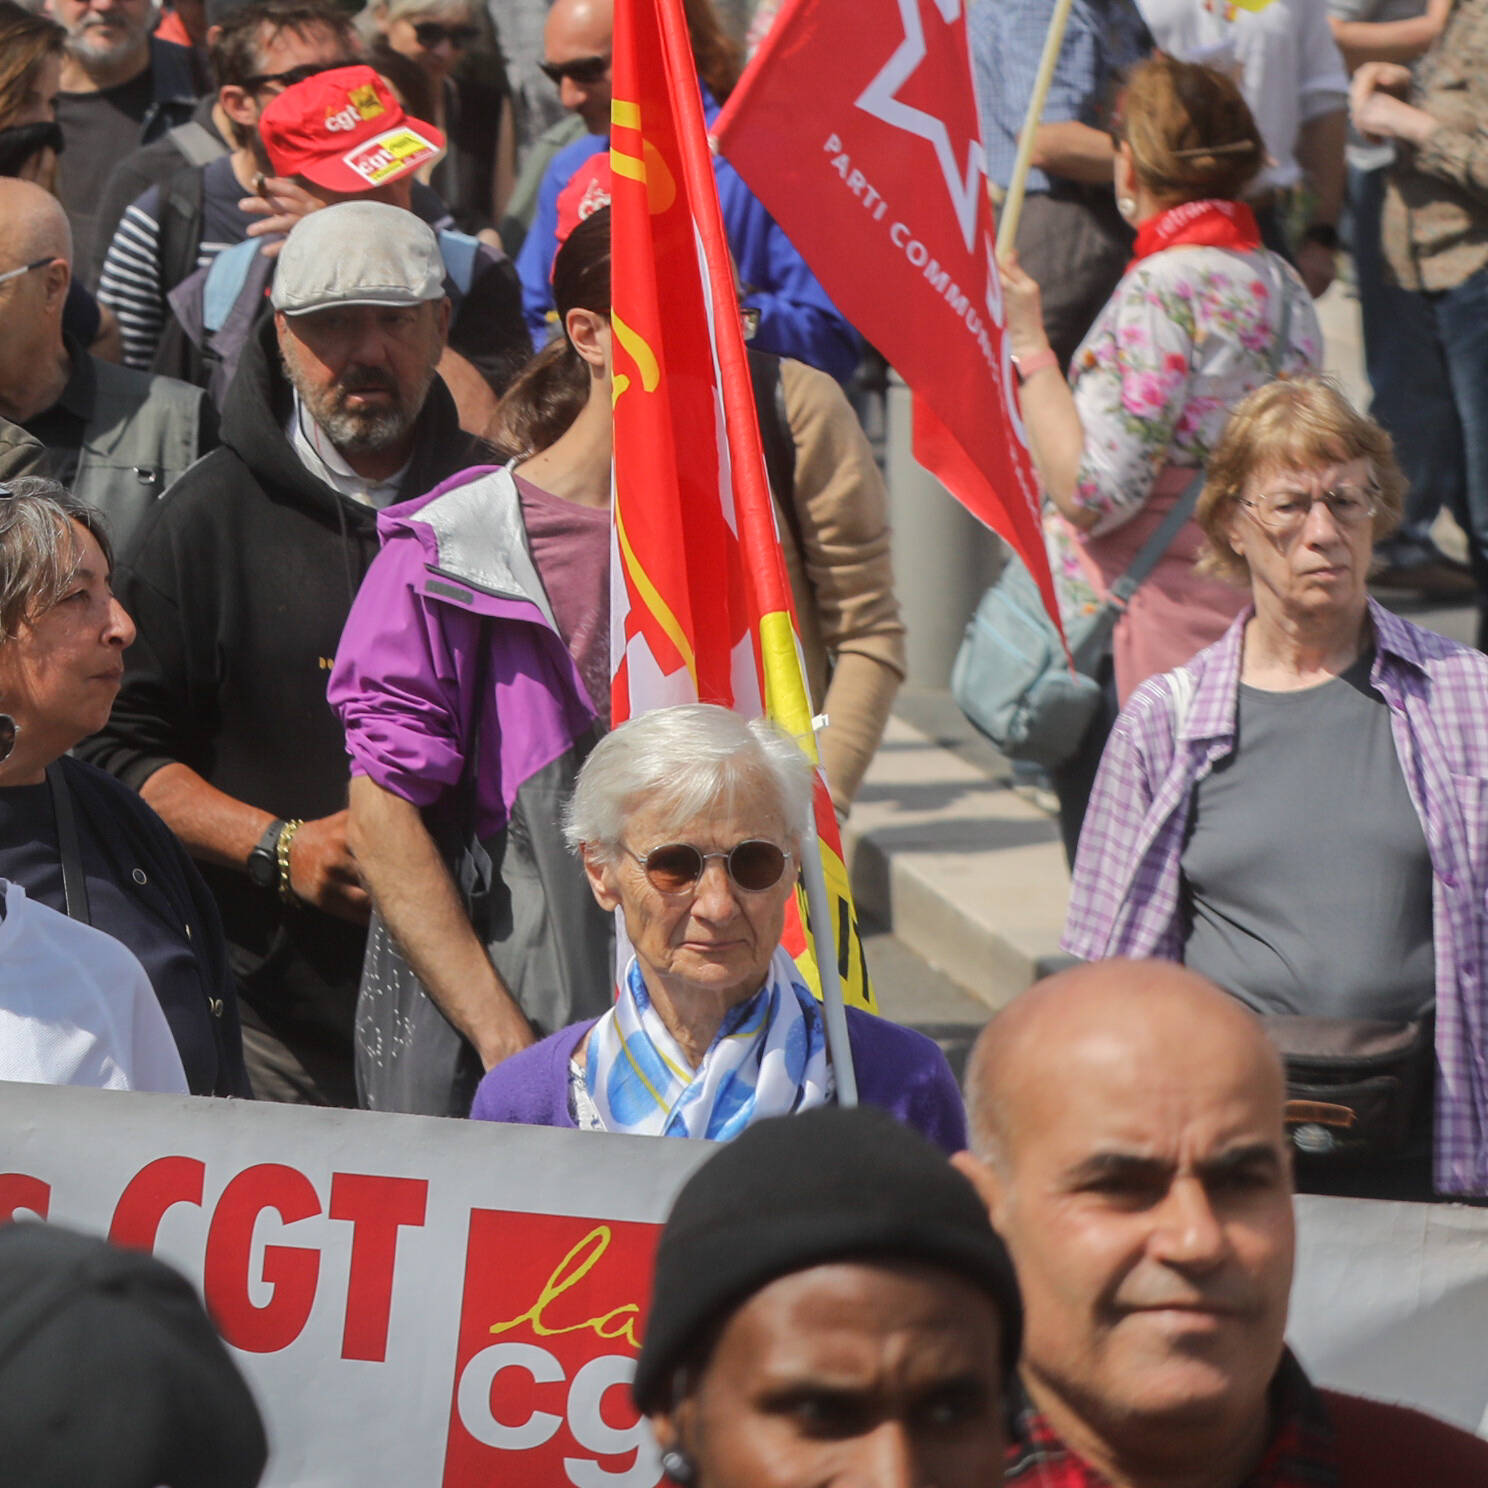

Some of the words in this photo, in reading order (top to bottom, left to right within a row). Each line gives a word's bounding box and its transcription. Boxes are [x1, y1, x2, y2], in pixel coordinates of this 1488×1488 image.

[324, 103, 362, 132] cgt
[824, 132, 888, 221] PARTI
[106, 1154, 428, 1365] CGT
[489, 1225, 644, 1349] la
[456, 1341, 669, 1488] cg
